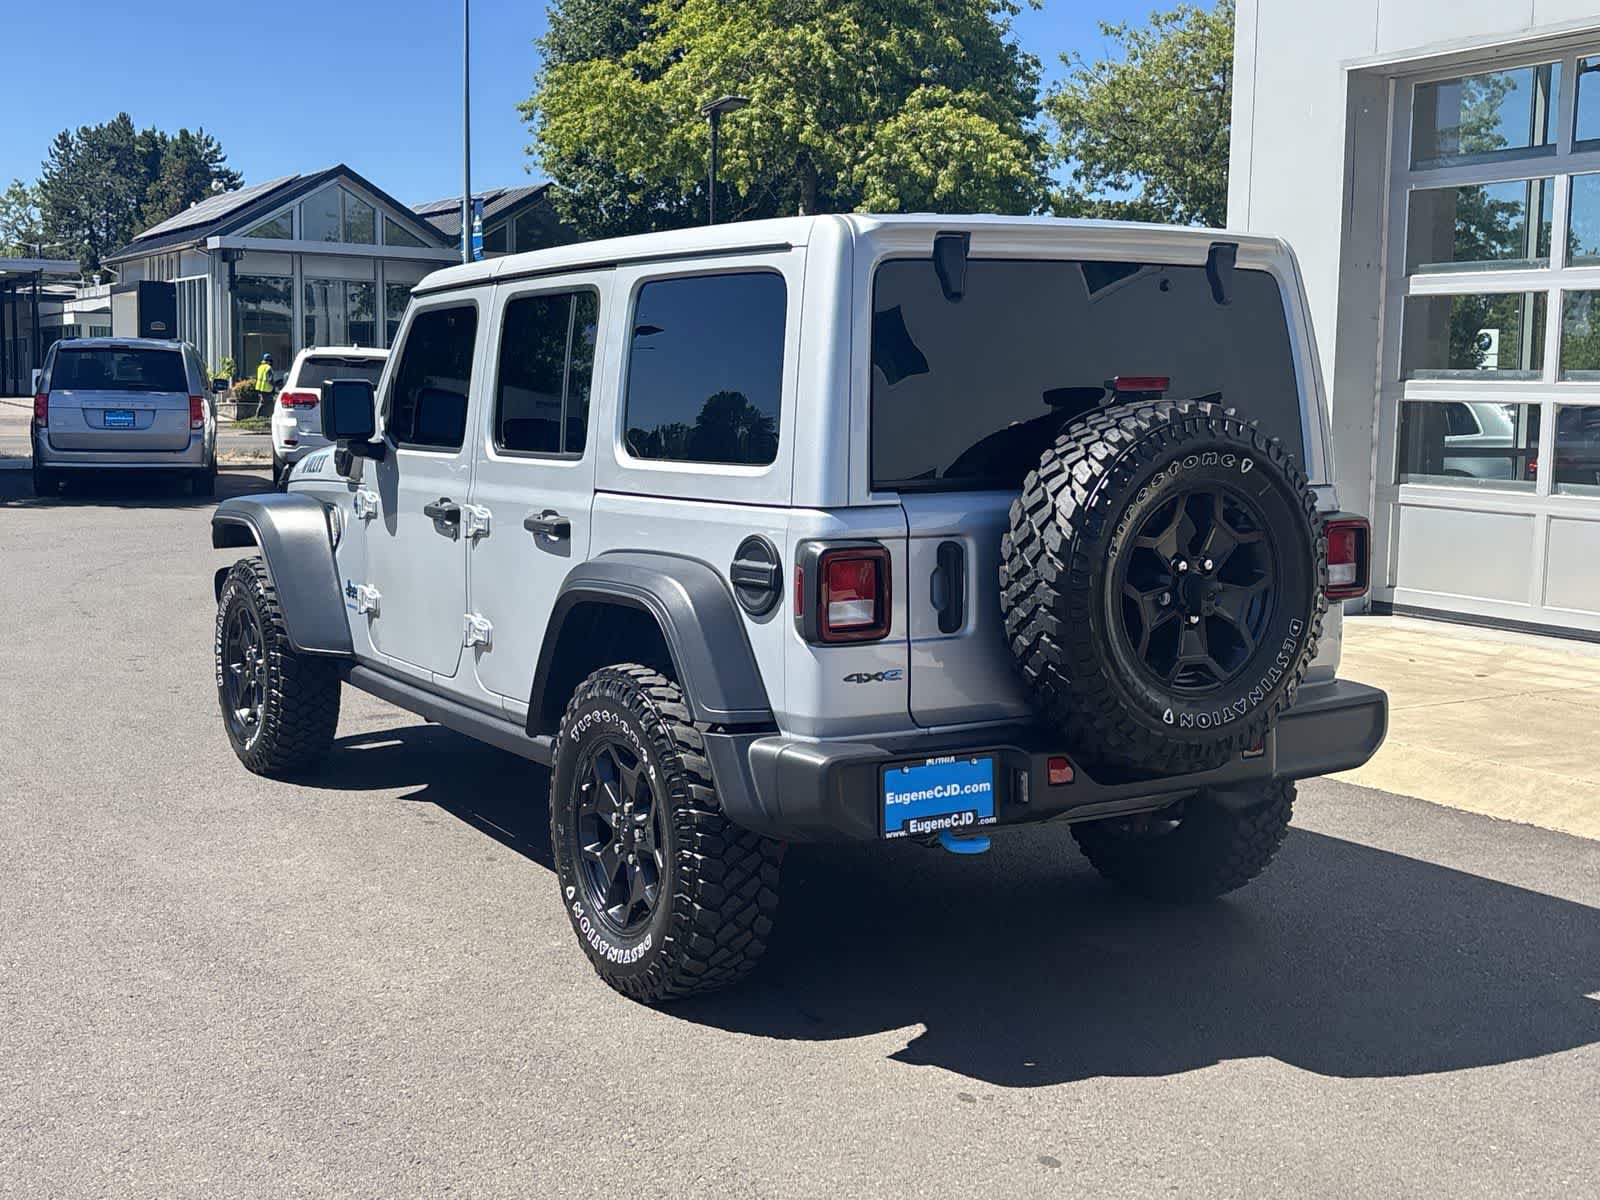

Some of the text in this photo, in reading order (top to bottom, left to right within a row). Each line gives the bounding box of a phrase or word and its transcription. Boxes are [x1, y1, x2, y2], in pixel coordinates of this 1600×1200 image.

[1179, 616, 1304, 729] DESTINATION
[886, 782, 991, 805] EugeneCJD.com
[909, 812, 974, 833] EugeneCJD
[572, 903, 653, 964] DESTINATION
